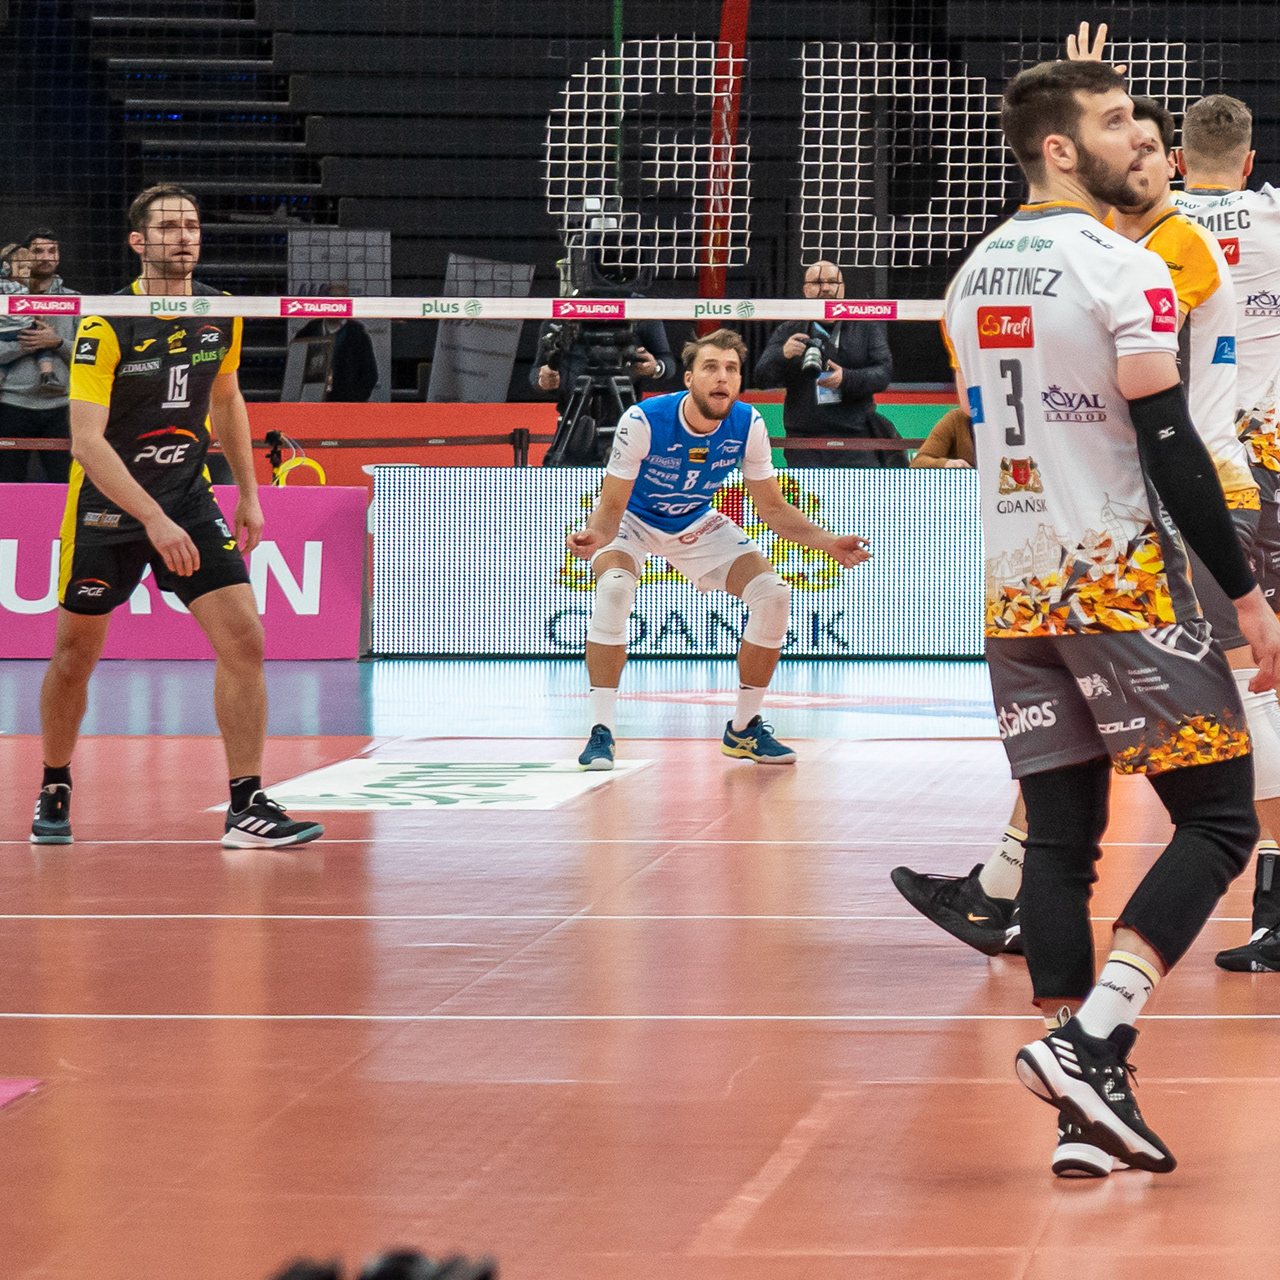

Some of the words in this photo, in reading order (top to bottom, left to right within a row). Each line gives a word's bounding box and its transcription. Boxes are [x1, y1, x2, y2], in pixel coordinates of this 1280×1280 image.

[1188, 209, 1251, 233] MIEC
[986, 237, 1016, 253] plus
[1028, 236, 1054, 252] liga
[960, 266, 1064, 299] MARTINEZ
[30, 300, 76, 311] TAURON
[150, 298, 187, 315] plus
[303, 302, 348, 312] TAURON
[422, 300, 460, 317] plus
[575, 303, 619, 314] TAURON
[694, 301, 732, 318] plus
[847, 305, 892, 315] TAURON
[1000, 314, 1032, 339] Trefl
[192, 349, 217, 366] plus
[1000, 358, 1026, 446] 3
[1045, 412, 1107, 422] EAFOOD
[134, 443, 191, 464] PGE
[682, 470, 701, 491] 8
[996, 498, 1048, 515] GDAŃSK
